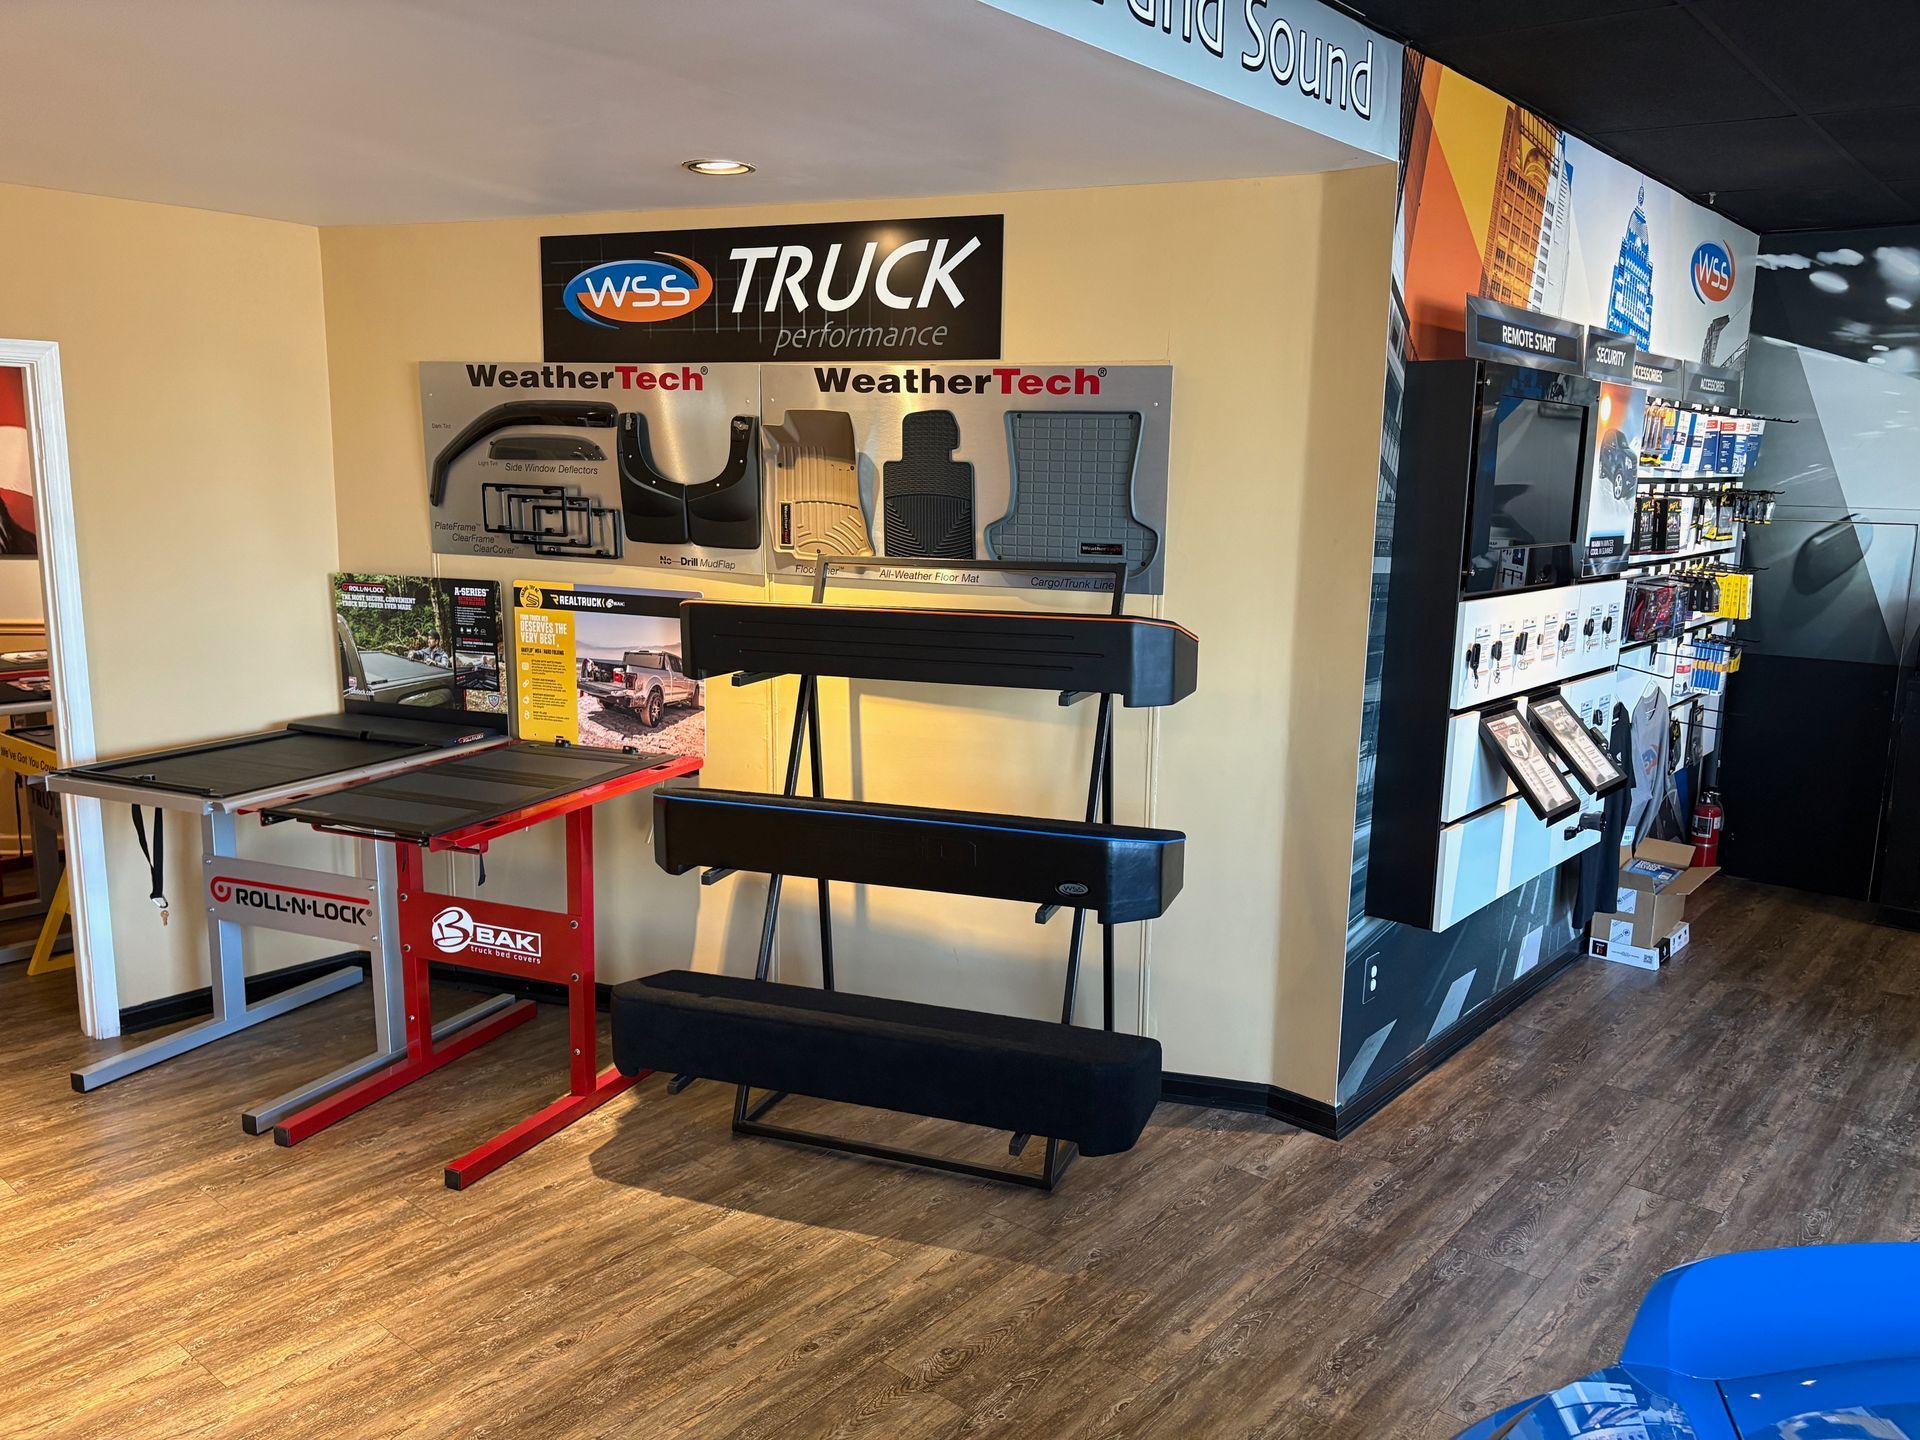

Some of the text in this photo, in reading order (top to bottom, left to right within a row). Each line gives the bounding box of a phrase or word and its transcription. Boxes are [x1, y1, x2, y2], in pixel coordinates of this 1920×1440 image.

[1241, 0, 1374, 121] Sound
[585, 236, 982, 314] WSS TRUCK
[1699, 249, 1729, 291] WSS
[773, 320, 948, 356] performance
[1502, 325, 1557, 353] REMOTE START
[1596, 346, 1626, 367] SECURITY
[505, 462, 598, 475] Side Window Deflectors
[700, 558, 736, 570] MudFlap
[879, 569, 980, 583] All-Weather Floor Mat
[1031, 576, 1090, 590] Cargo/Trunk
[559, 595, 602, 608] REALTRUCK
[520, 621, 568, 635] DESERVES THE
[520, 632, 538, 643] VERY
[476, 927, 536, 952] BAK
[470, 946, 541, 965] truck bed covers
